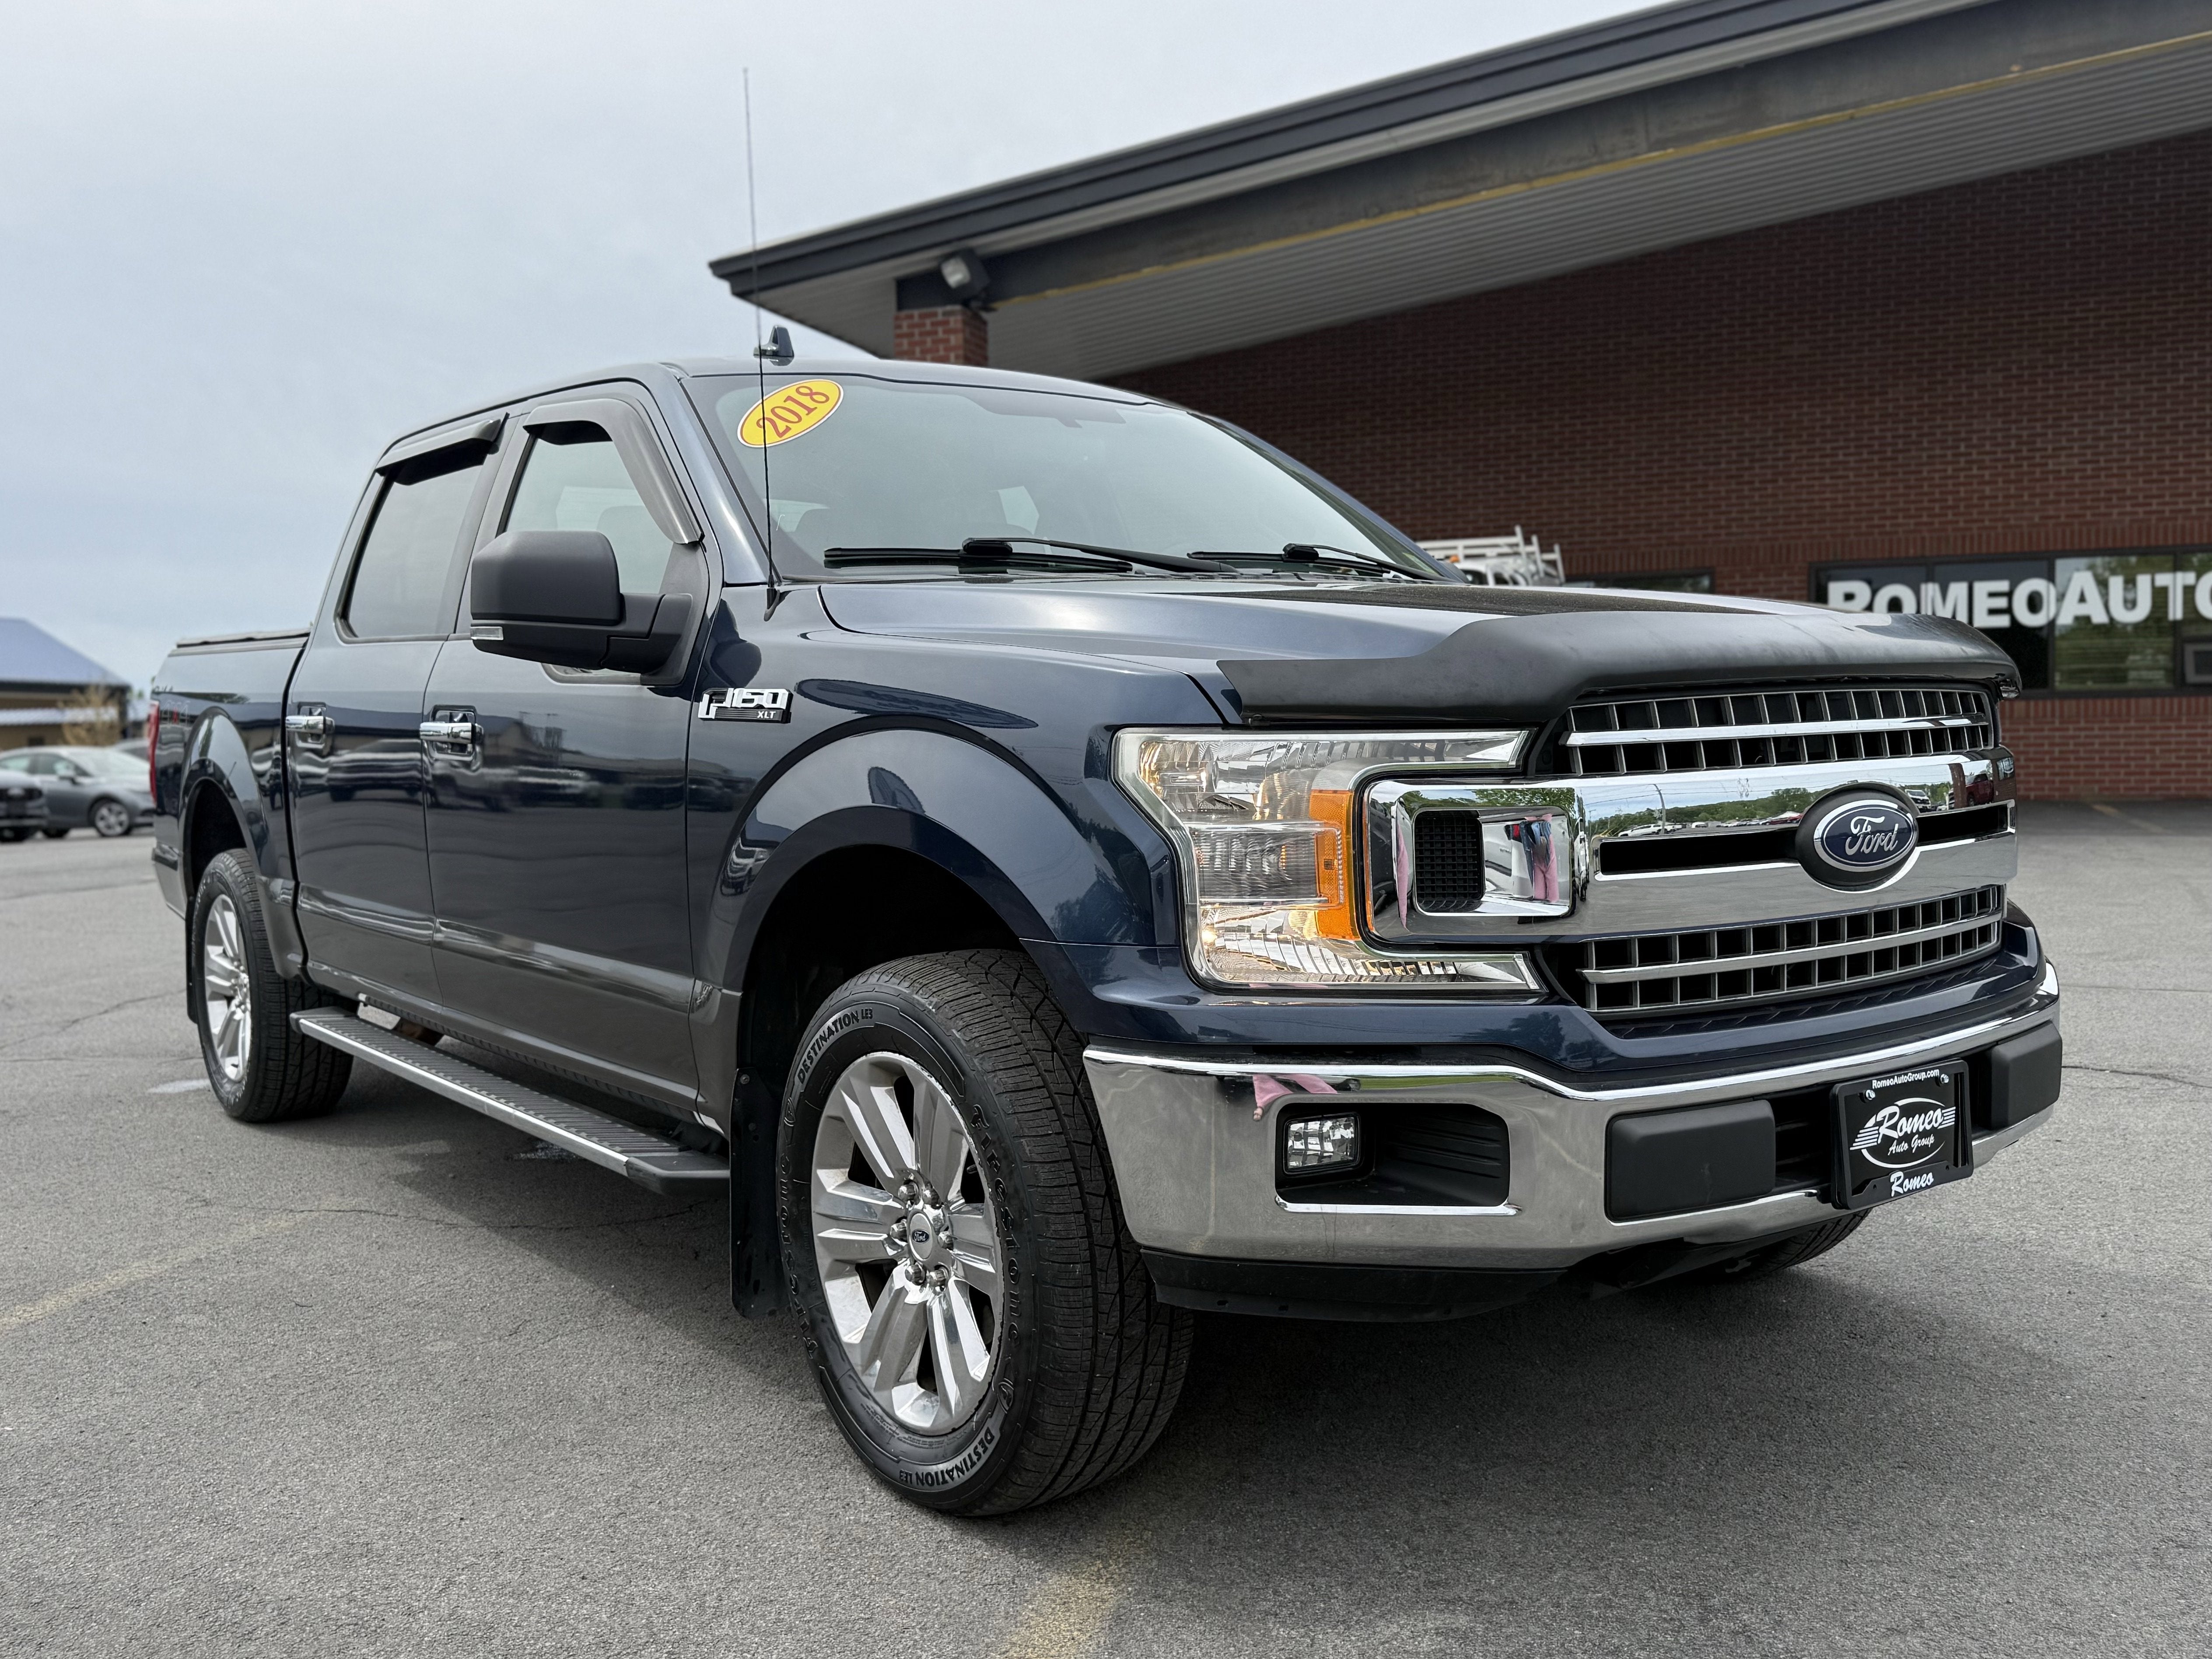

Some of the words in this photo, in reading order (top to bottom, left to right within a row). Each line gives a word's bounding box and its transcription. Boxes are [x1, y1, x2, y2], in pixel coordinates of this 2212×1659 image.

[756, 386, 830, 438] 2018
[1845, 816, 1898, 855] Ford
[797, 1010, 860, 1084] DESTINATION
[1872, 1069, 1939, 1089] RomeoAutoGroup.com
[1876, 1106, 1944, 1144] Romeo
[1887, 1140, 1909, 1155] Auto
[1911, 1134, 1935, 1153] Group
[1890, 1171, 1934, 1197] Romeo
[914, 1232, 926, 1241] Ford
[915, 1426, 995, 1487] DESTINATION
